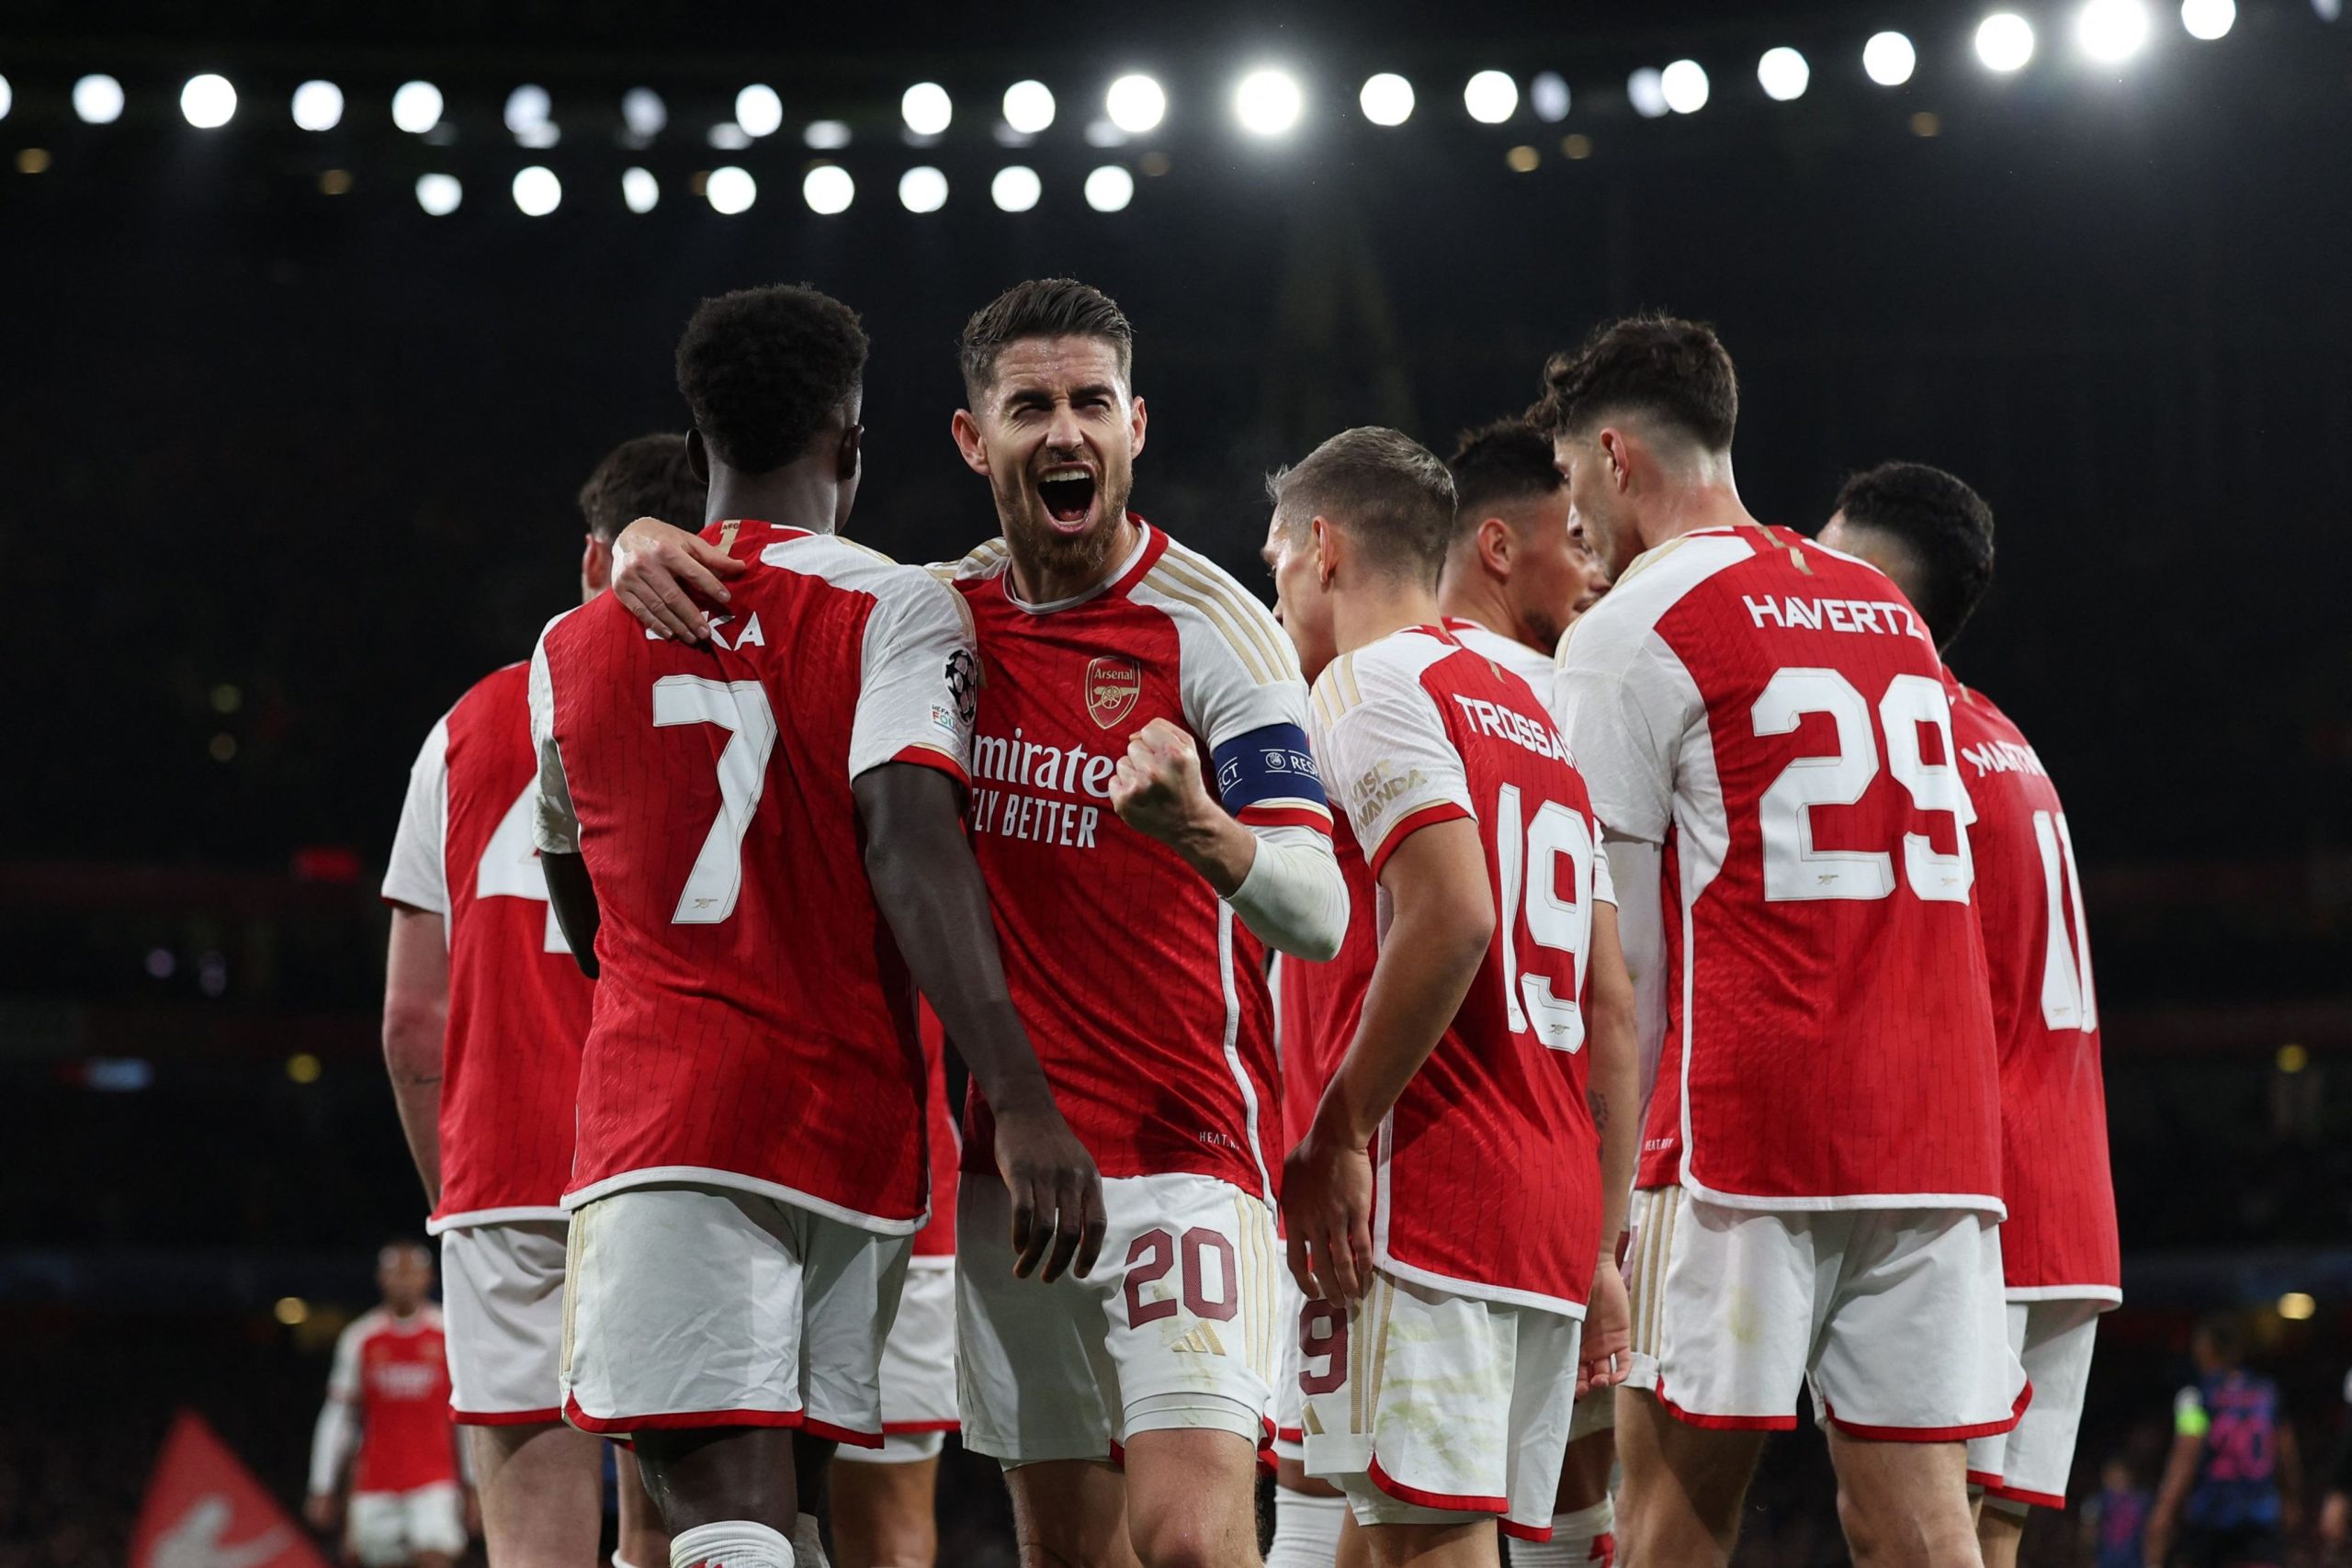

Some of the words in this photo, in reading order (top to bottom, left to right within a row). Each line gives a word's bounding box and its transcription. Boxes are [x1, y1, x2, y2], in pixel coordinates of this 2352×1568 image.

[1742, 594, 1926, 642] HAVERTZ
[1094, 668, 1133, 681] Arsenal
[932, 711, 959, 733] FOU
[1453, 693, 1582, 774] TROSSAR
[652, 674, 778, 924] 7
[972, 728, 1114, 798] mirate
[1218, 762, 1238, 794] ECT
[1356, 769, 1428, 830] WANDA
[1750, 667, 1978, 907] 29
[1001, 794, 1099, 849] BETTER
[1497, 782, 1595, 1055] 19
[2032, 809, 2098, 1034] 11
[1124, 1226, 1238, 1330] 20
[1299, 1299, 1348, 1395] 9
